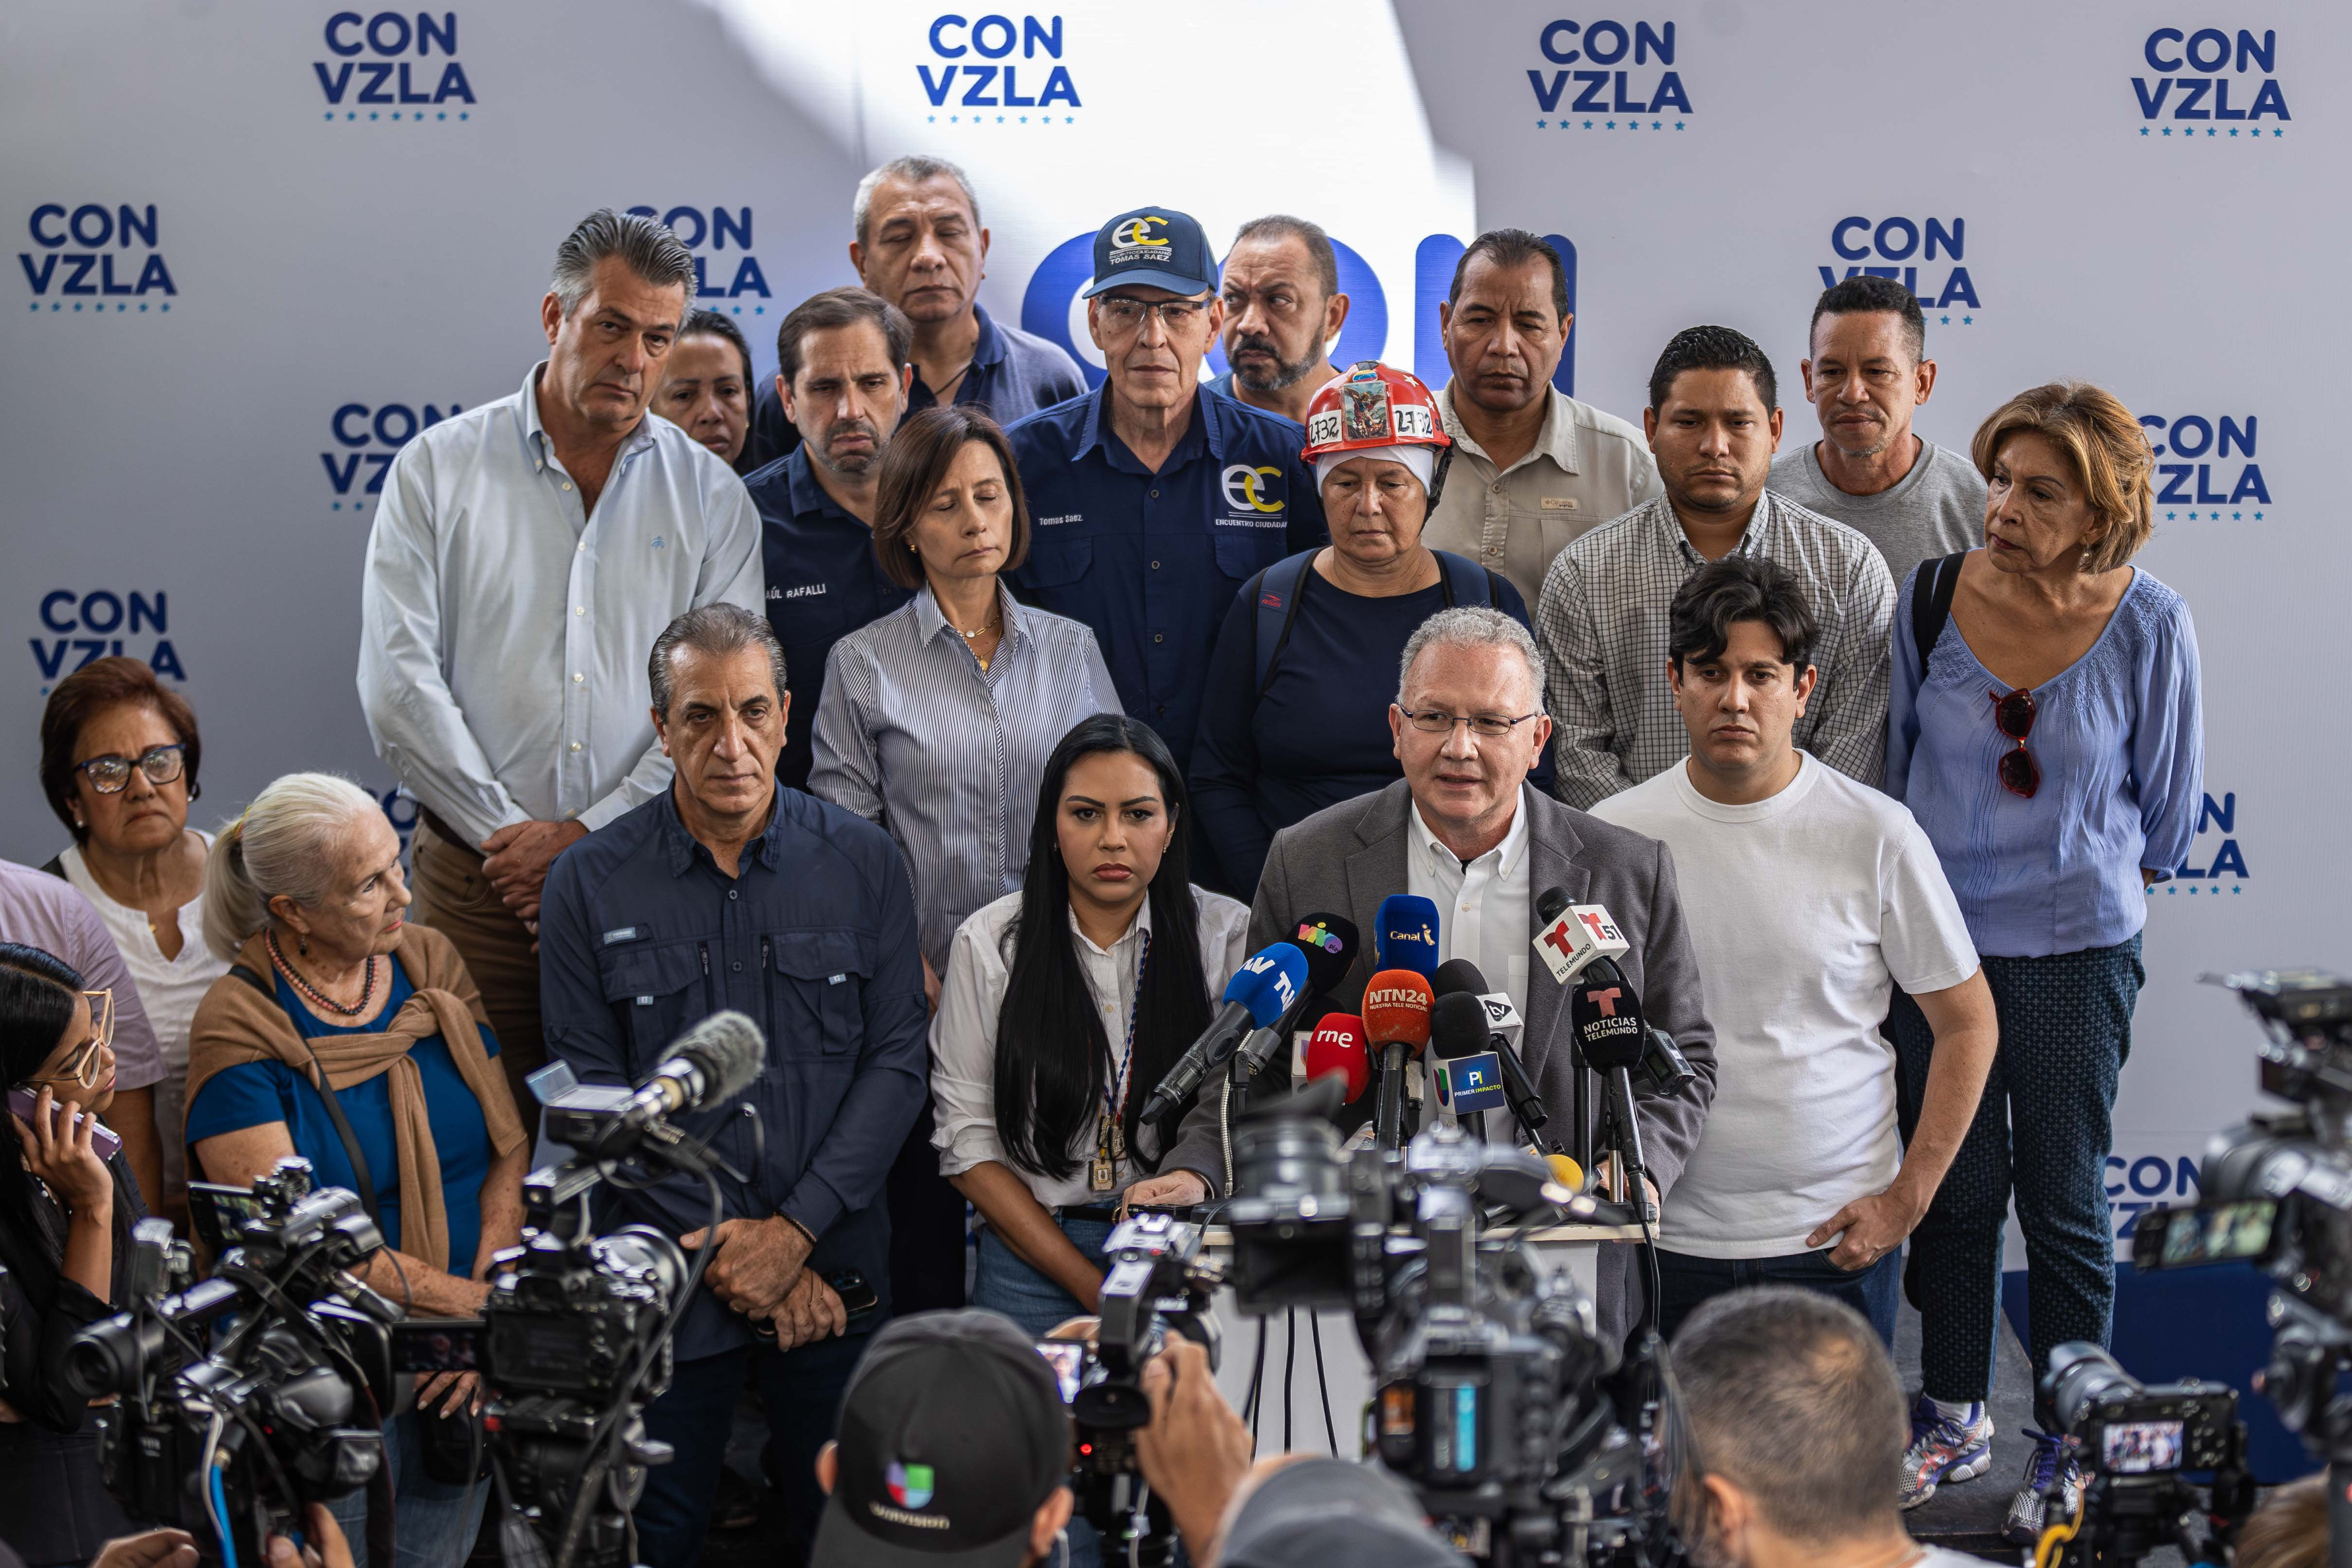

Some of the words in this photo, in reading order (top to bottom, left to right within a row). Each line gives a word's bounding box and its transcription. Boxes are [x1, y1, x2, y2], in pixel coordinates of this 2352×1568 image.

[324, 12, 457, 56] CON
[929, 15, 1062, 58] CON
[1540, 19, 1675, 65] CON
[2145, 28, 2275, 73] CON
[313, 62, 476, 104] VZLA
[916, 65, 1081, 107] VZLA
[1526, 70, 1693, 113] VZLA
[2130, 77, 2291, 121] VZLA
[29, 204, 157, 248] CON
[1832, 216, 1964, 261] CON
[18, 254, 177, 295] VZLA
[1110, 254, 1140, 265] TOMAS
[1143, 254, 1170, 262] SAEZ
[2150, 464, 2272, 504] ZLA
[1039, 517, 1064, 525] Tomas
[1065, 515, 1083, 523] Saez
[1216, 519, 1254, 527] ENCUENTRO
[787, 583, 827, 598] RAFALLI
[40, 590, 167, 635] CON
[1390, 931, 1421, 942] Canal
[1602, 925, 1622, 940] 51
[1556, 943, 1591, 977] TELEMUNDO
[1369, 989, 1428, 1006] NTN24
[1405, 1003, 1428, 1012] NOTICIAS
[1317, 1030, 1353, 1048] rne
[1583, 1017, 1637, 1034] NOTICIAS
[1586, 1027, 1638, 1042] TELEMUNDO
[1454, 1089, 1475, 1097] PRIMER
[1475, 1084, 1501, 1093] IMPACTO
[1468, 1071, 1483, 1086] PI
